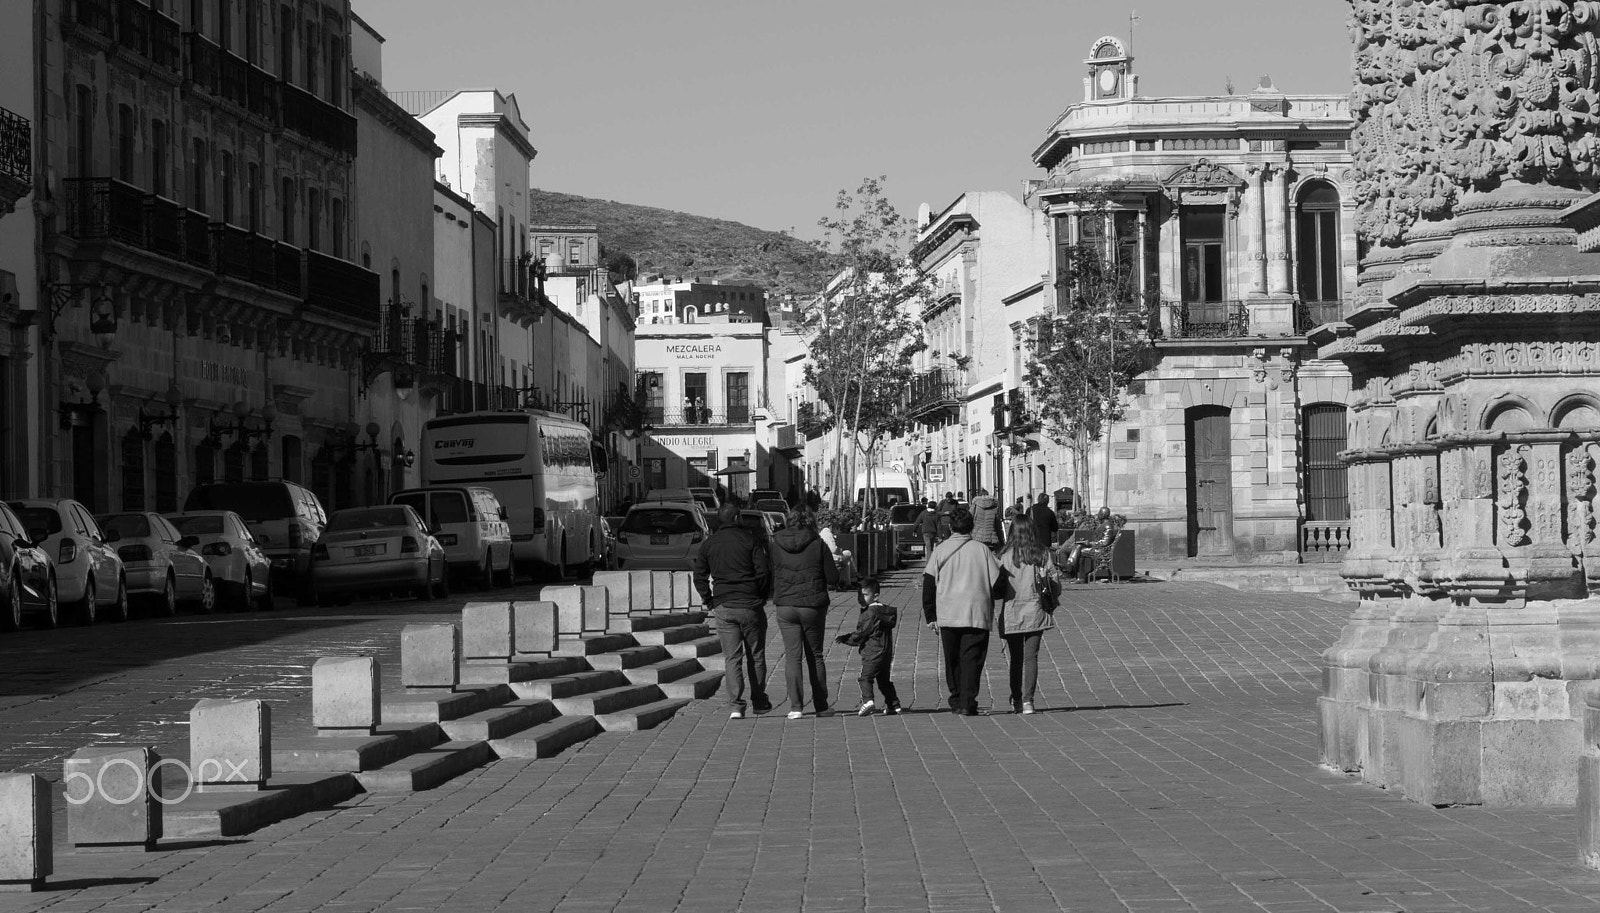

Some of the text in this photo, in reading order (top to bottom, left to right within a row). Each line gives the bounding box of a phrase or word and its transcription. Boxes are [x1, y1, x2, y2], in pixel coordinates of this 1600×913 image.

[666, 344, 722, 353] MEZCALERA
[657, 437, 680, 446] INDIO
[682, 437, 715, 446] ALEGRE
